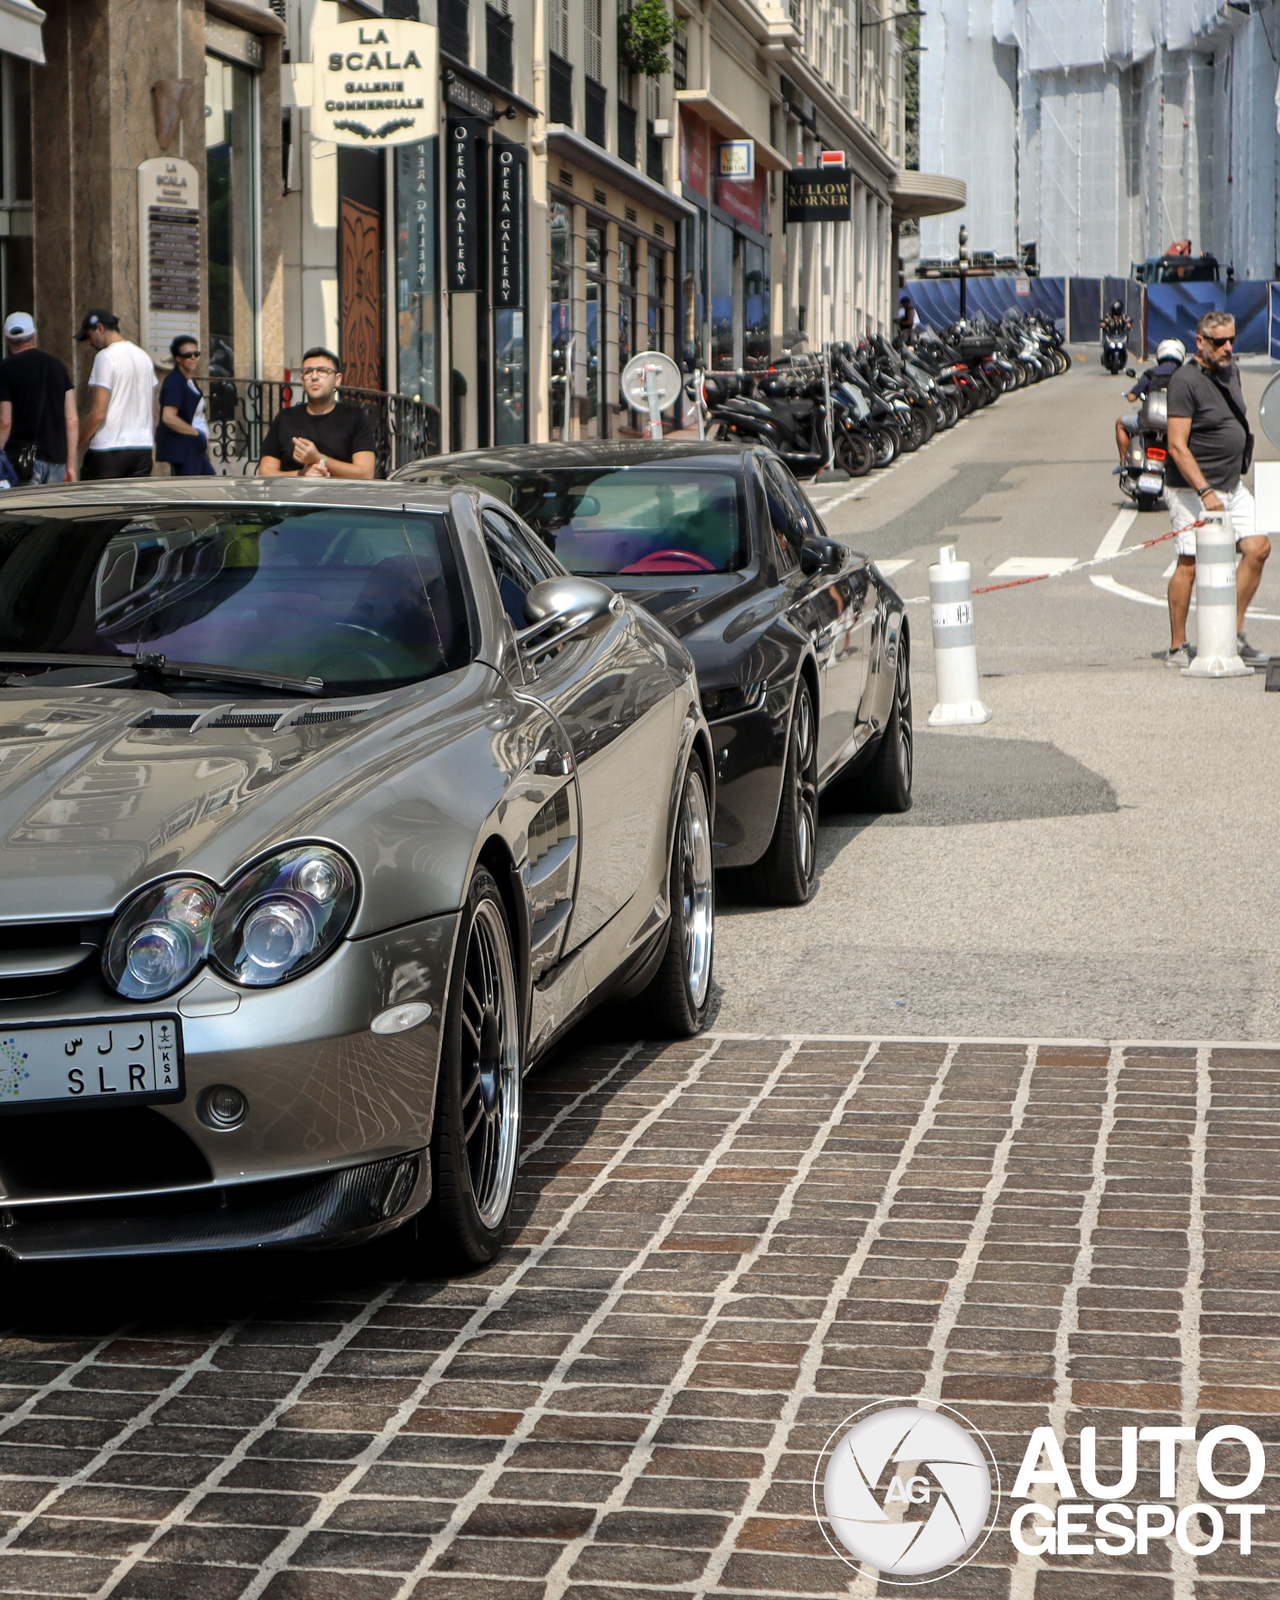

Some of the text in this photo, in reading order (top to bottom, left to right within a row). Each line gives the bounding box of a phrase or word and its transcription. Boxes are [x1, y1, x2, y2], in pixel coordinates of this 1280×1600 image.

[358, 27, 389, 45] LA
[328, 50, 422, 71] SCALA
[344, 81, 404, 93] GALERIE
[325, 98, 424, 112] COMMERCIALE
[722, 164, 747, 172] TINTIN
[790, 183, 849, 195] YELLOW
[454, 126, 467, 285] OPERA GALLERY
[789, 194, 849, 206] KORNER
[500, 151, 513, 300] OPERA GALLERY
